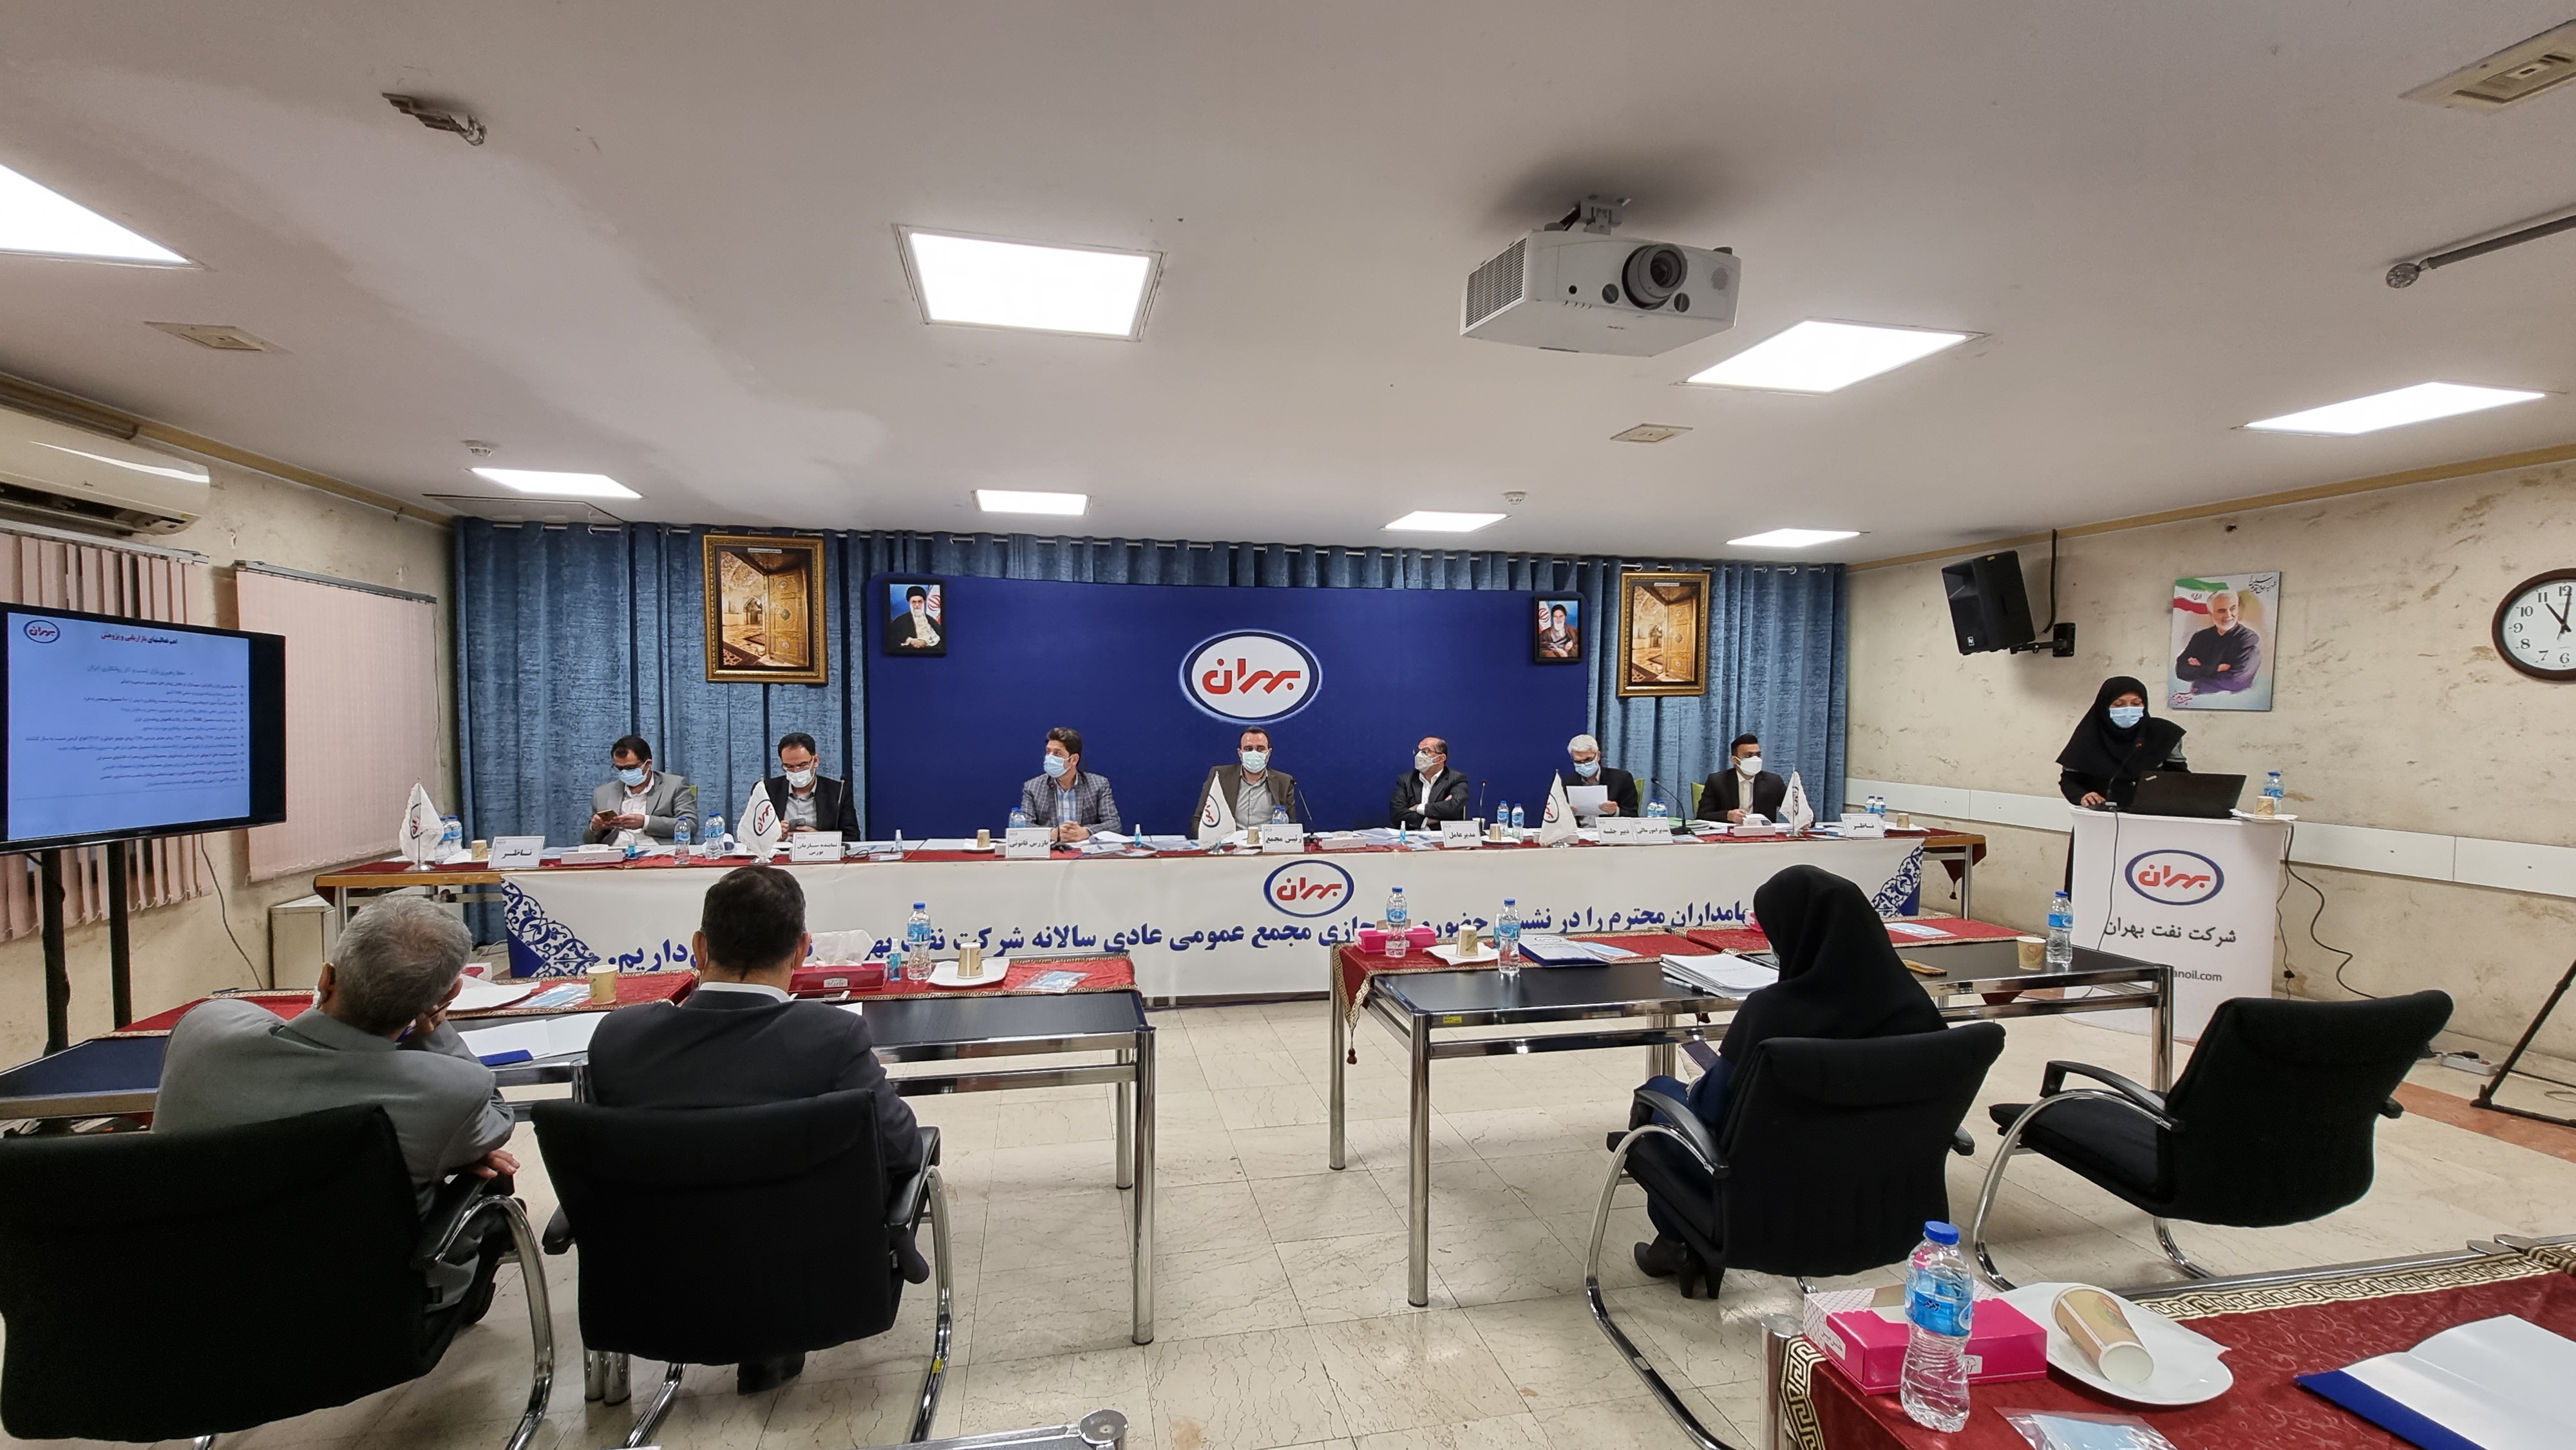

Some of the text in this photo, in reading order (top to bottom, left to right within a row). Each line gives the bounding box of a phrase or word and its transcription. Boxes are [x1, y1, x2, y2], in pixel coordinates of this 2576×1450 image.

[2559, 585, 2572, 596] 12
[2537, 592, 2548, 603] 11
[2521, 606, 2533, 617] 10
[28, 626, 56, 637] بهران
[2513, 623, 2523, 633] 9
[2521, 639, 2531, 649] 8
[2538, 650, 2549, 661] 7
[2559, 652, 2570, 664] 6
[1202, 657, 1301, 695] بهران
[1284, 834, 1302, 843] رئیس
[1449, 831, 1463, 840] عامل
[1009, 838, 1049, 848] بازرس قانونی
[501, 848, 533, 860] ناظر
[2137, 864, 2211, 889] بهران
[1276, 876, 1342, 901] بهران
[1520, 907, 1551, 930] نشس
[1558, 910, 1580, 934] در
[1586, 905, 1604, 932] را
[1609, 907, 1665, 931] محترم
[1032, 925, 1097, 948] سالانه
[1104, 923, 1162, 952] عادی
[1170, 925, 1245, 951] عمومی
[1251, 925, 1312, 948] مجمع
[2104, 916, 2237, 947] شرکت نفت بهران
[2173, 969, 2222, 982] anoil.com
